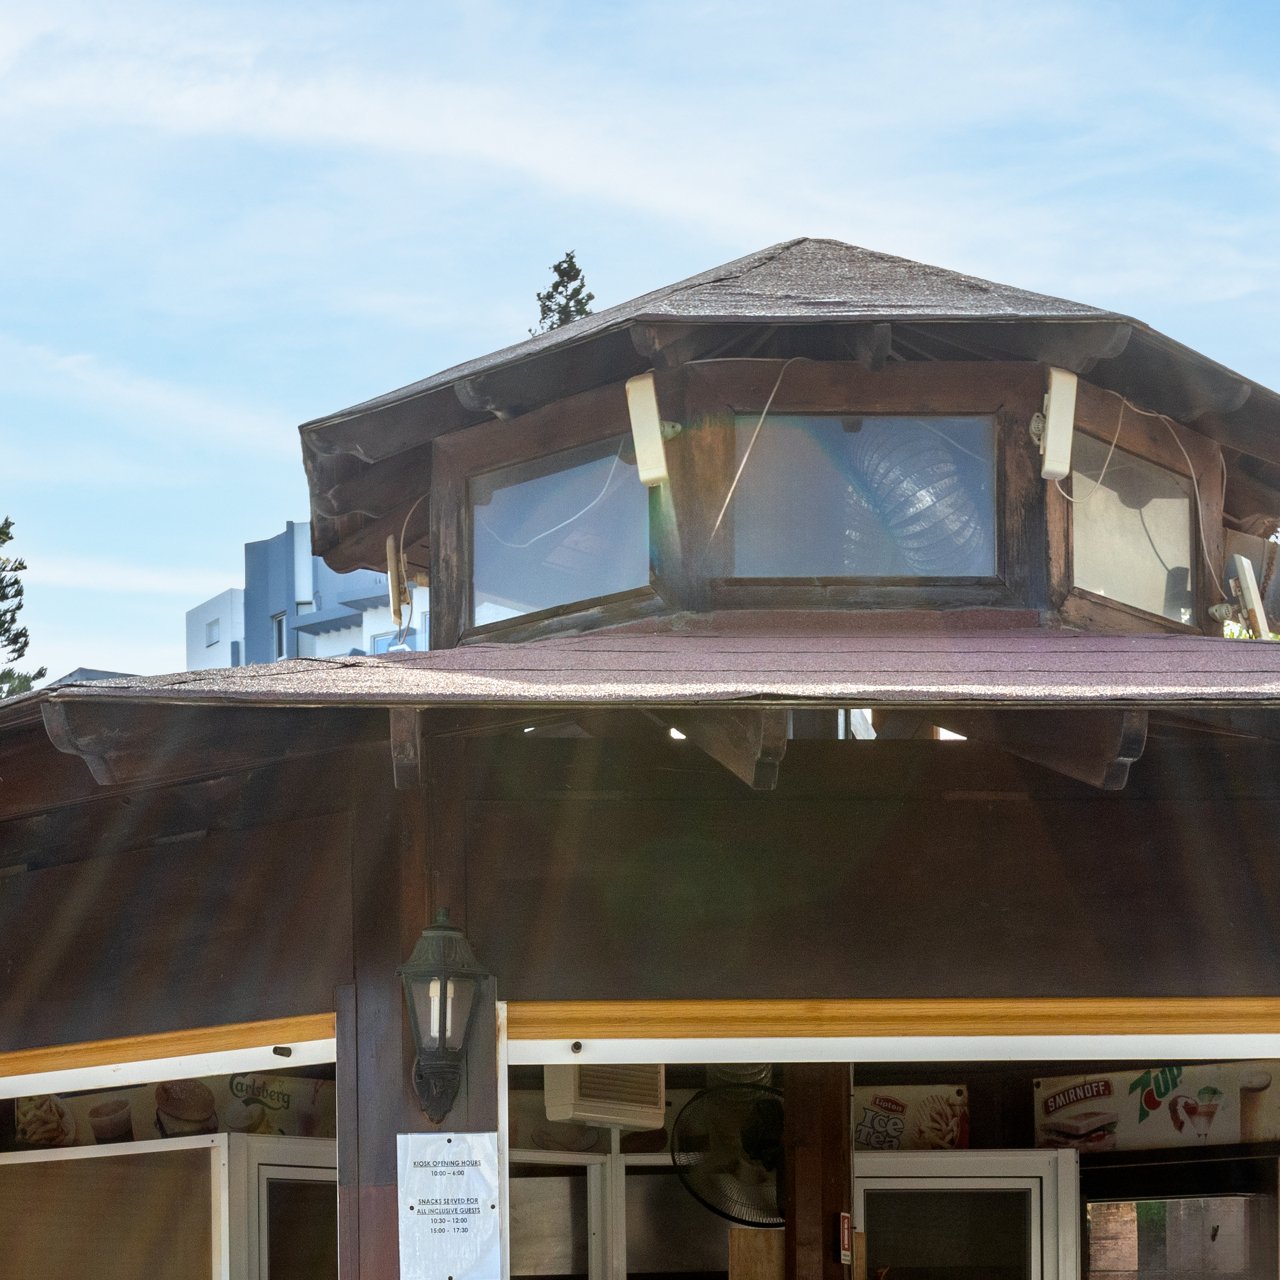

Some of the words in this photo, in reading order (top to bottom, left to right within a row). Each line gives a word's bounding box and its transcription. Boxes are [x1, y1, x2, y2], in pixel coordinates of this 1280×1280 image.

[229, 1073, 290, 1110] Carlsberg
[875, 1097, 903, 1112] Lipton
[1047, 1081, 1106, 1112] SMIRNOFF
[854, 1123, 900, 1150] Tea
[862, 1107, 904, 1137] Ice
